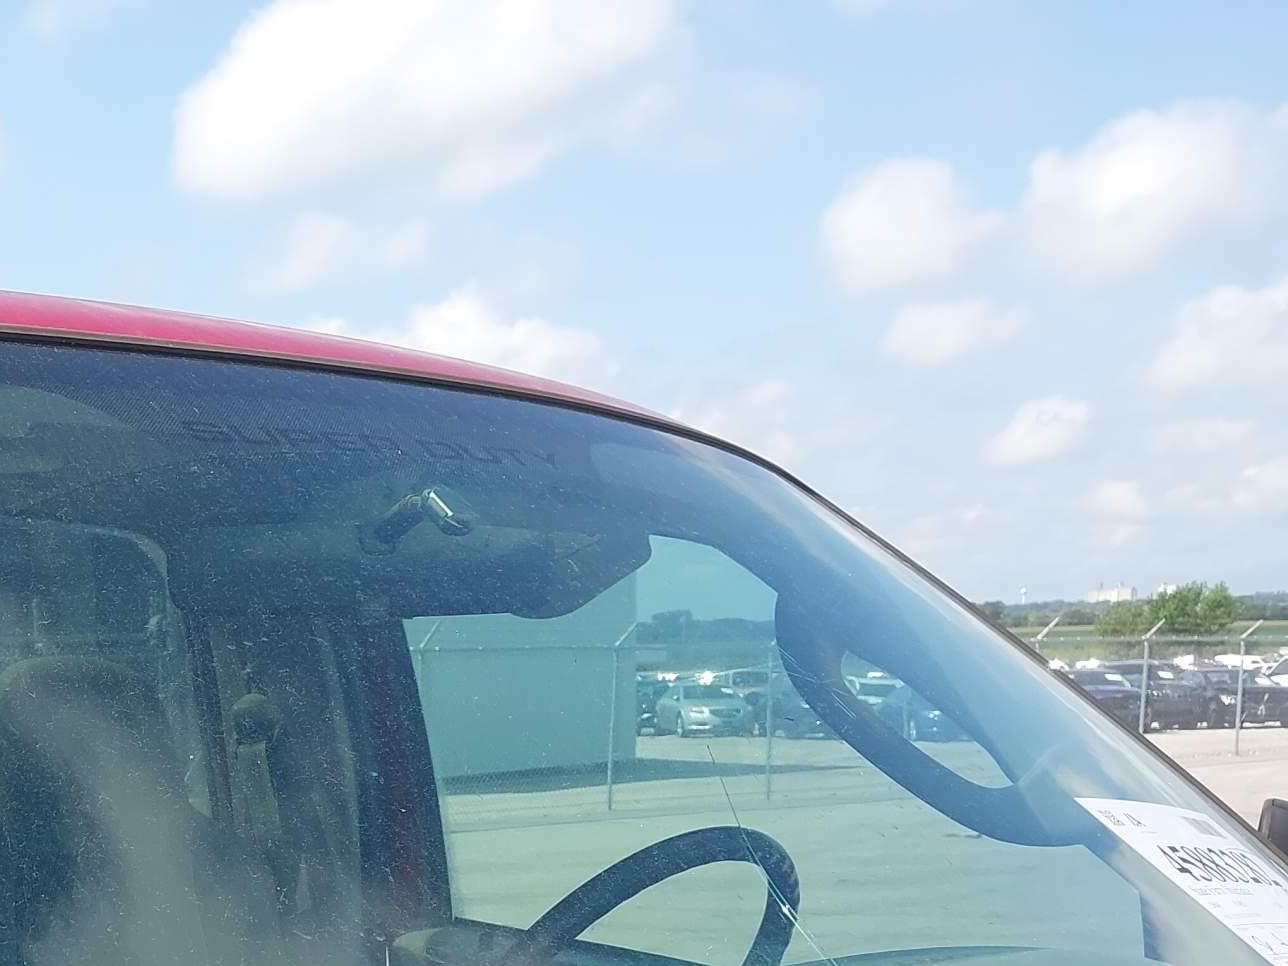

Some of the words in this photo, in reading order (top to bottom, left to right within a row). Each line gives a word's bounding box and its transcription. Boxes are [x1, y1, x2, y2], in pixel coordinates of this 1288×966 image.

[180, 420, 407, 457] SUPER
[414, 438, 558, 469] DUTY
[1156, 844, 1283, 888] 45883282
